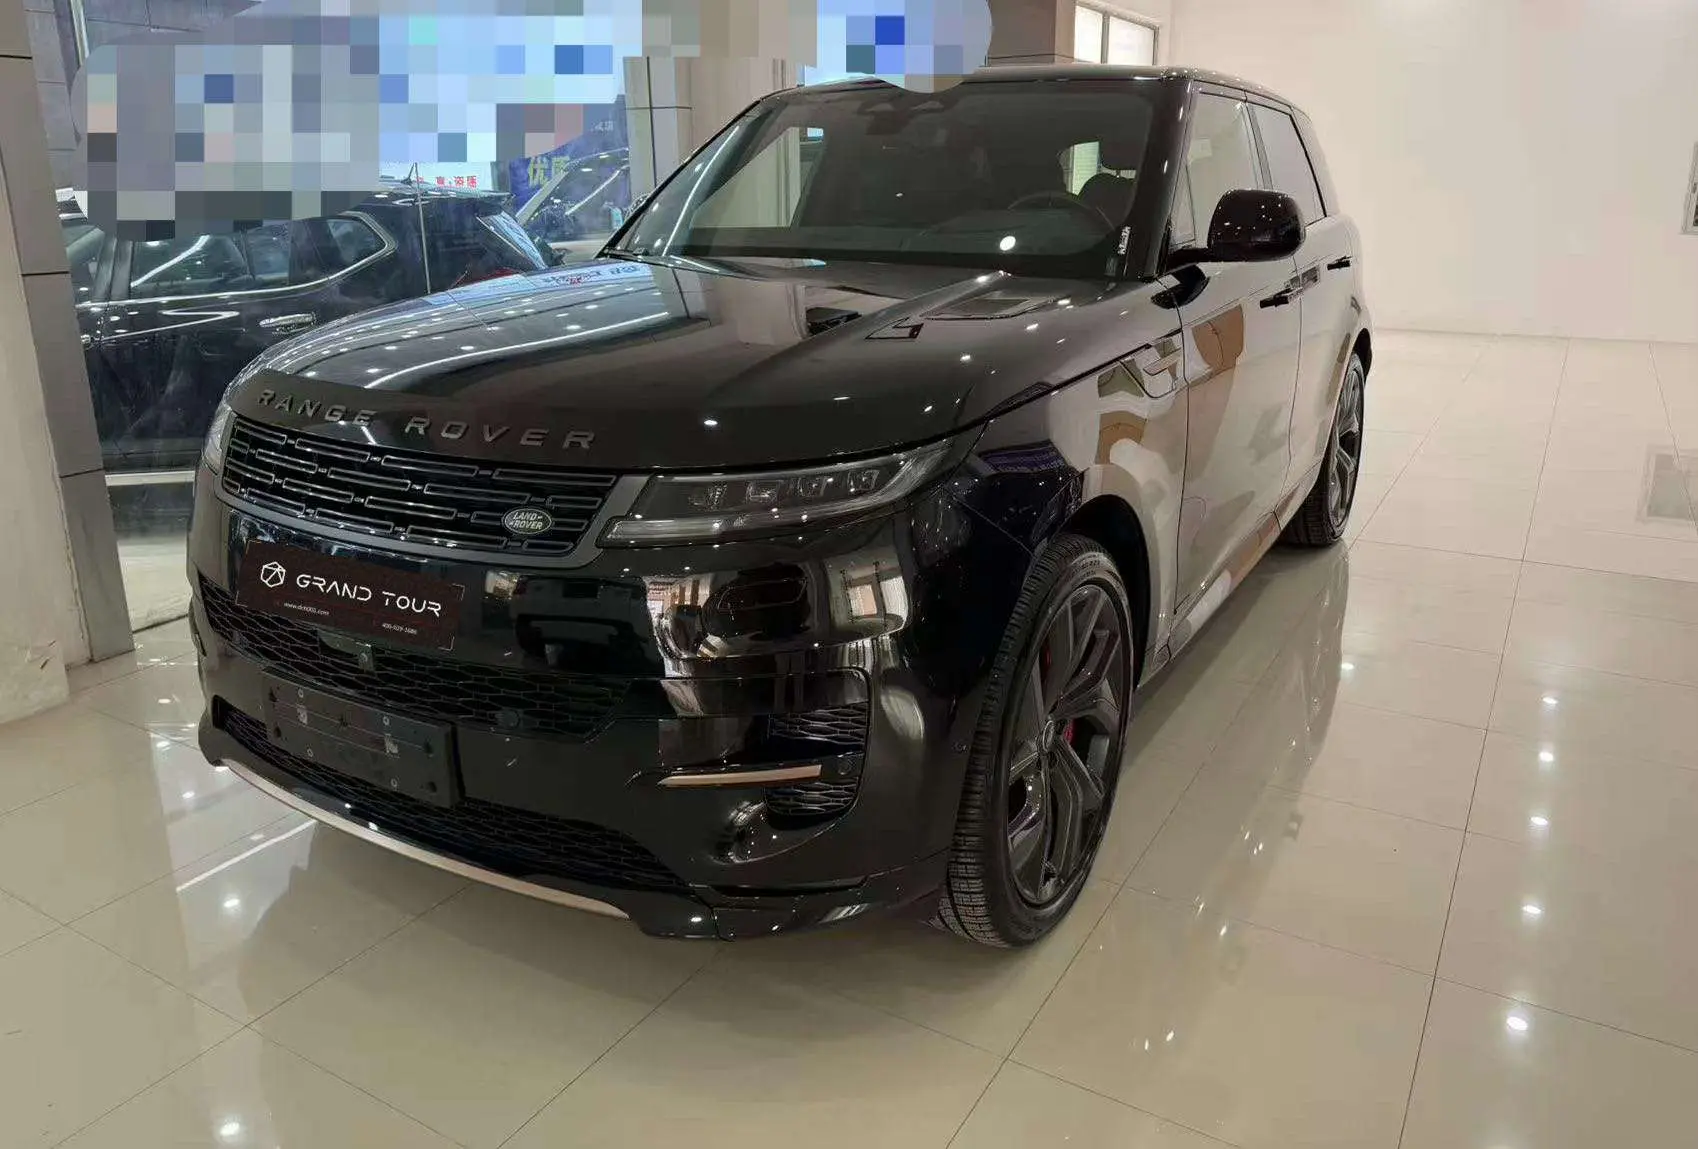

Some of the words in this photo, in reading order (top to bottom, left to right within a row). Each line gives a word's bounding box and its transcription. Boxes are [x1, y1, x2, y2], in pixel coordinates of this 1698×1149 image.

[257, 389, 378, 427] RANGE
[404, 416, 596, 450] ROVER
[296, 574, 372, 602] GRAND
[382, 590, 442, 617] TOUR
